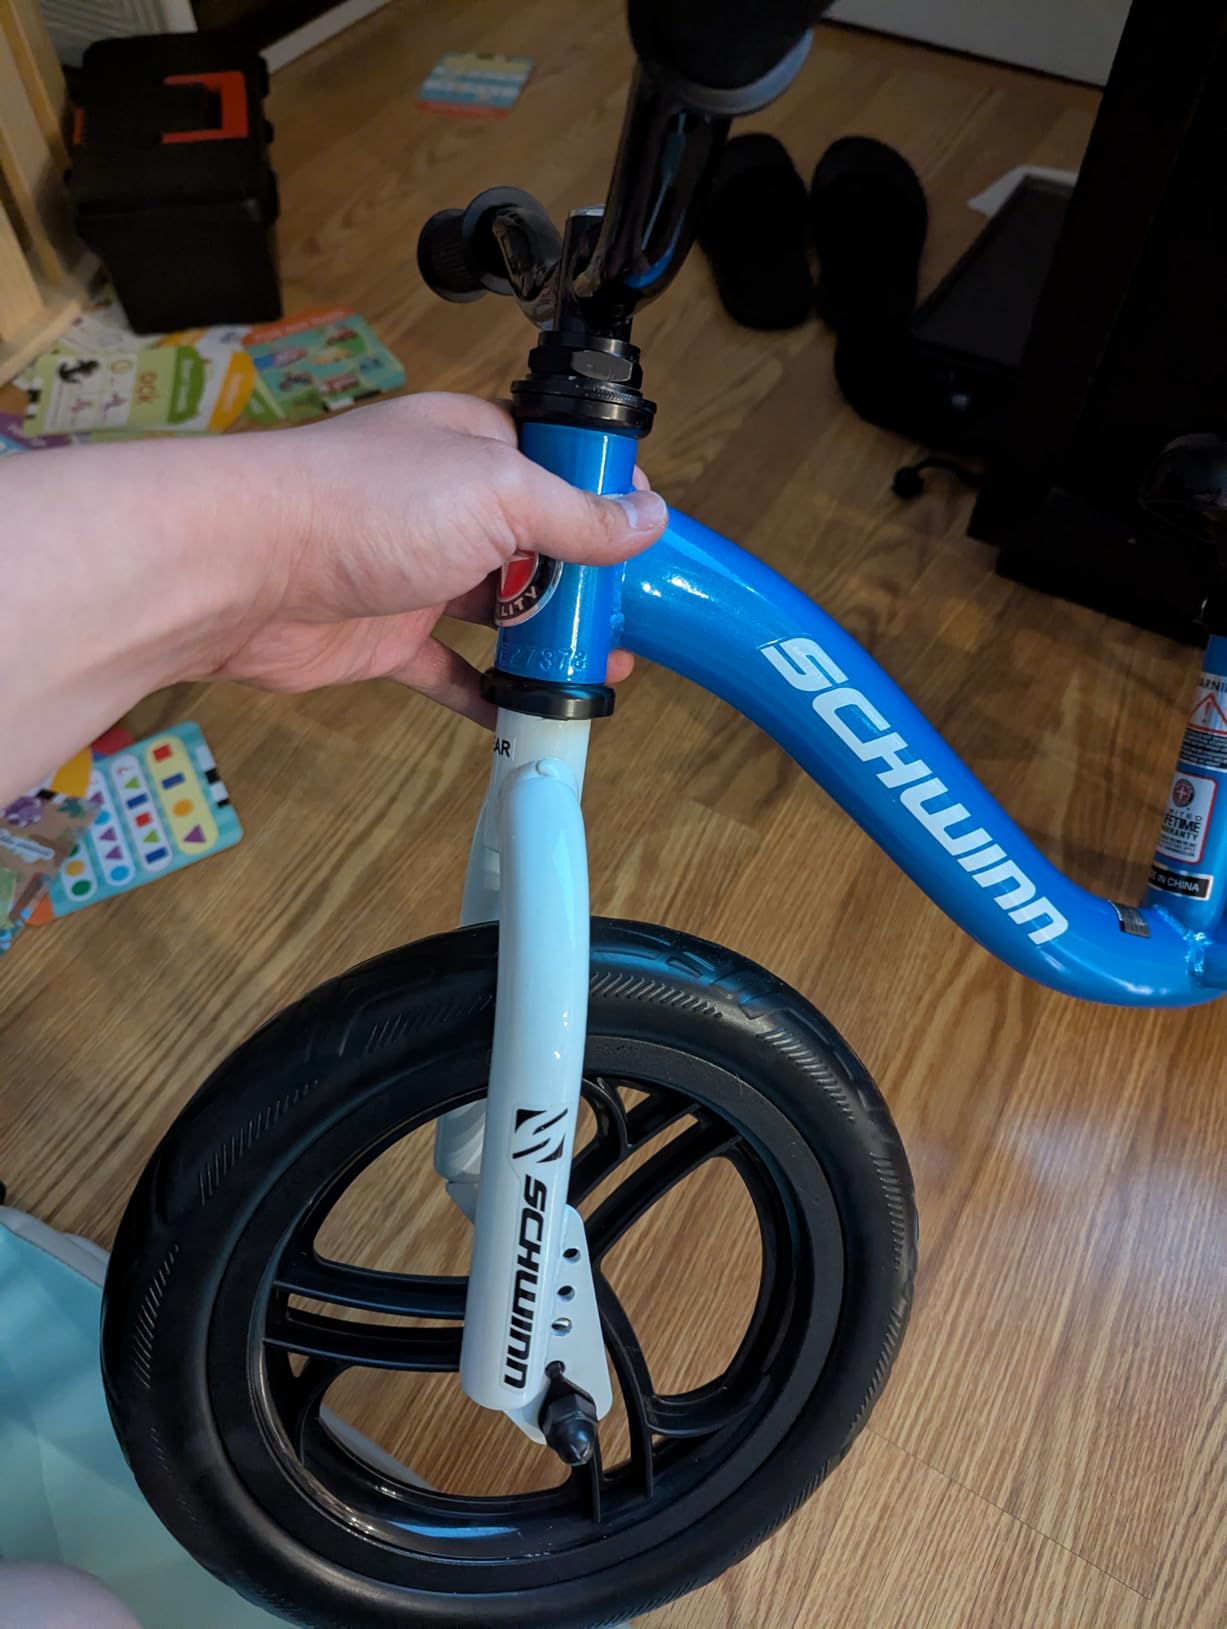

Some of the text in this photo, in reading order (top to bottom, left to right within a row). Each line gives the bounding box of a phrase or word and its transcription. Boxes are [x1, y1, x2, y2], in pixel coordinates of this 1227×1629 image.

[496, 585, 537, 617] LITY
[493, 736, 511, 758] AR
[760, 637, 1068, 945] SCHWINN
[1163, 813, 1201, 833] FETIME
[1168, 807, 1202, 821] MITED
[1167, 876, 1200, 892] CHINA
[504, 1173, 548, 1389] SCHWINN
